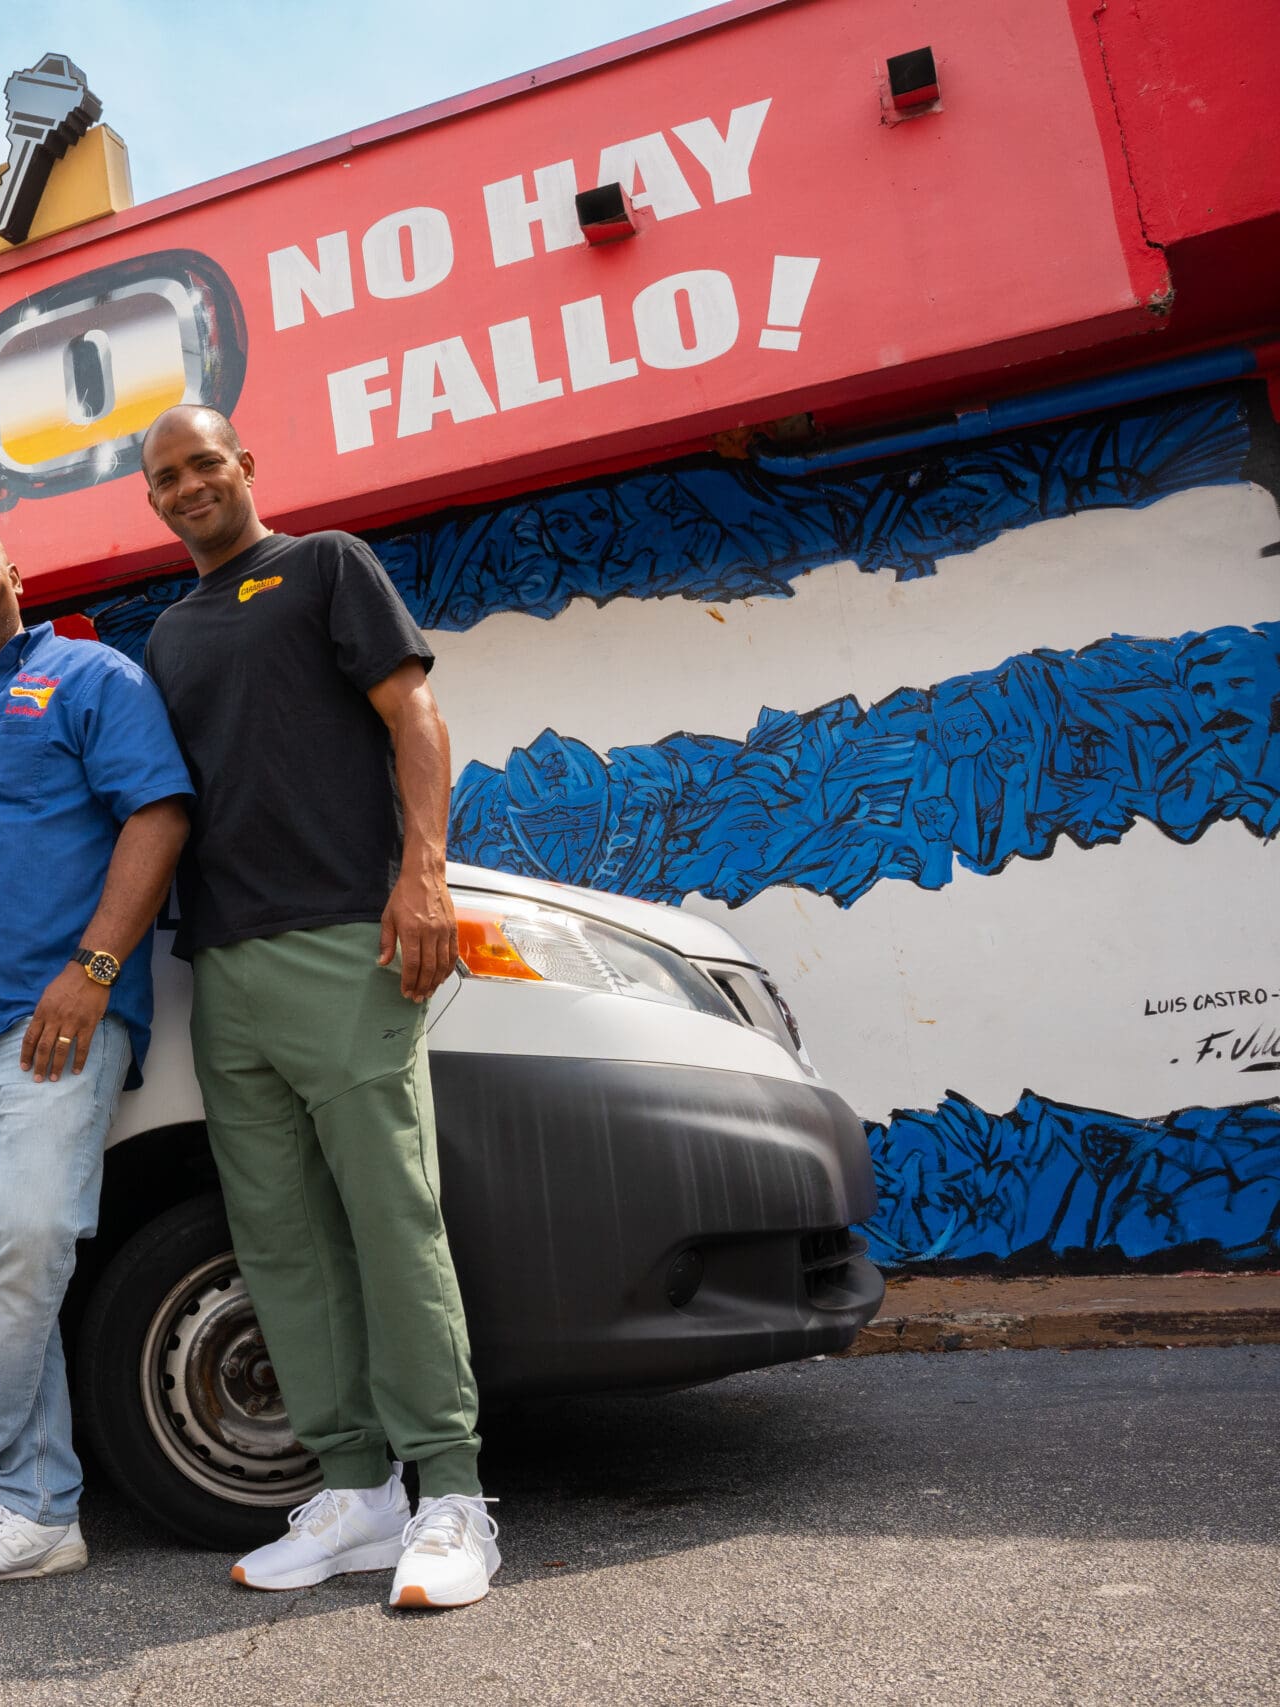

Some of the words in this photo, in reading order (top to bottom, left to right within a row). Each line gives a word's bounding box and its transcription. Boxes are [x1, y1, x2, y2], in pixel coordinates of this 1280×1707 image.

[267, 206, 454, 331] NO
[483, 98, 772, 268] HAY
[1144, 997, 1187, 1016] LUIS
[1193, 988, 1268, 1011] CASTRO
